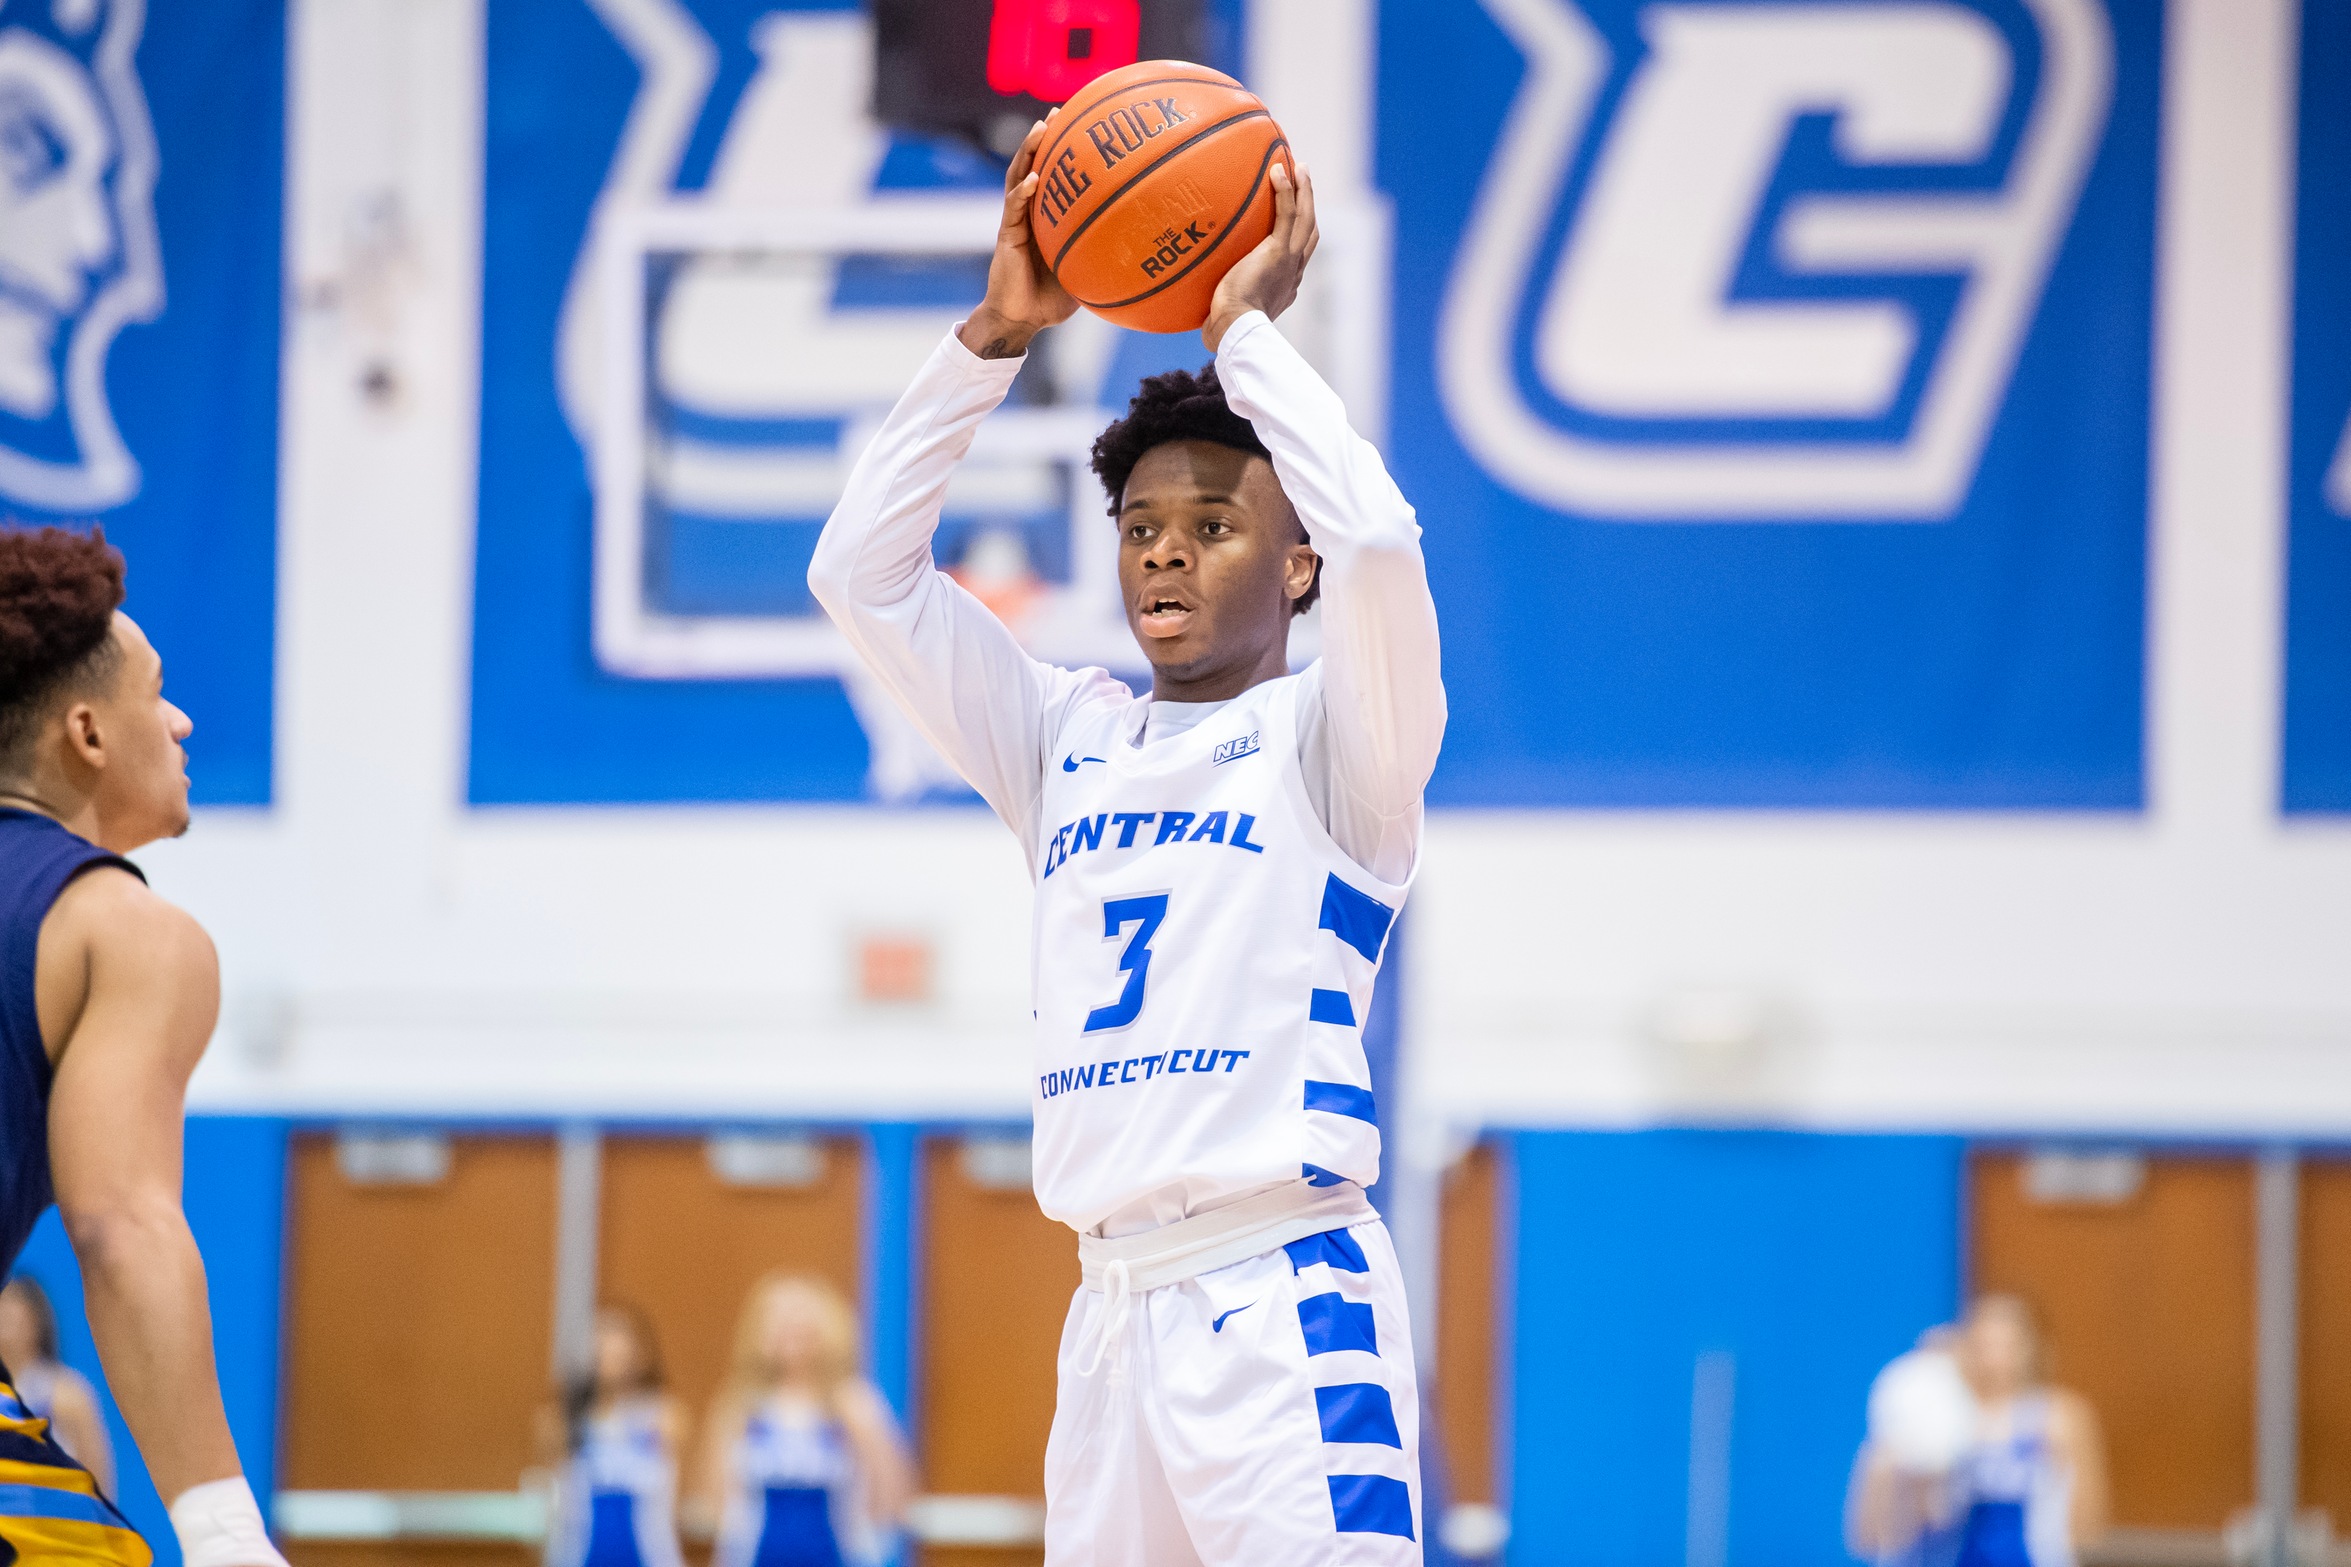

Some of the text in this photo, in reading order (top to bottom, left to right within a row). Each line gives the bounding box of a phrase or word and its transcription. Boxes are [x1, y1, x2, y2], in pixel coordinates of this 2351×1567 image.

[1040, 146, 1093, 229] THE
[1152, 227, 1177, 248] THE
[1212, 730, 1260, 765] NEC
[1043, 810, 1266, 880] CENTRAL
[1080, 888, 1173, 1039] 3
[1040, 1048, 1252, 1100] CONNECTICUT
